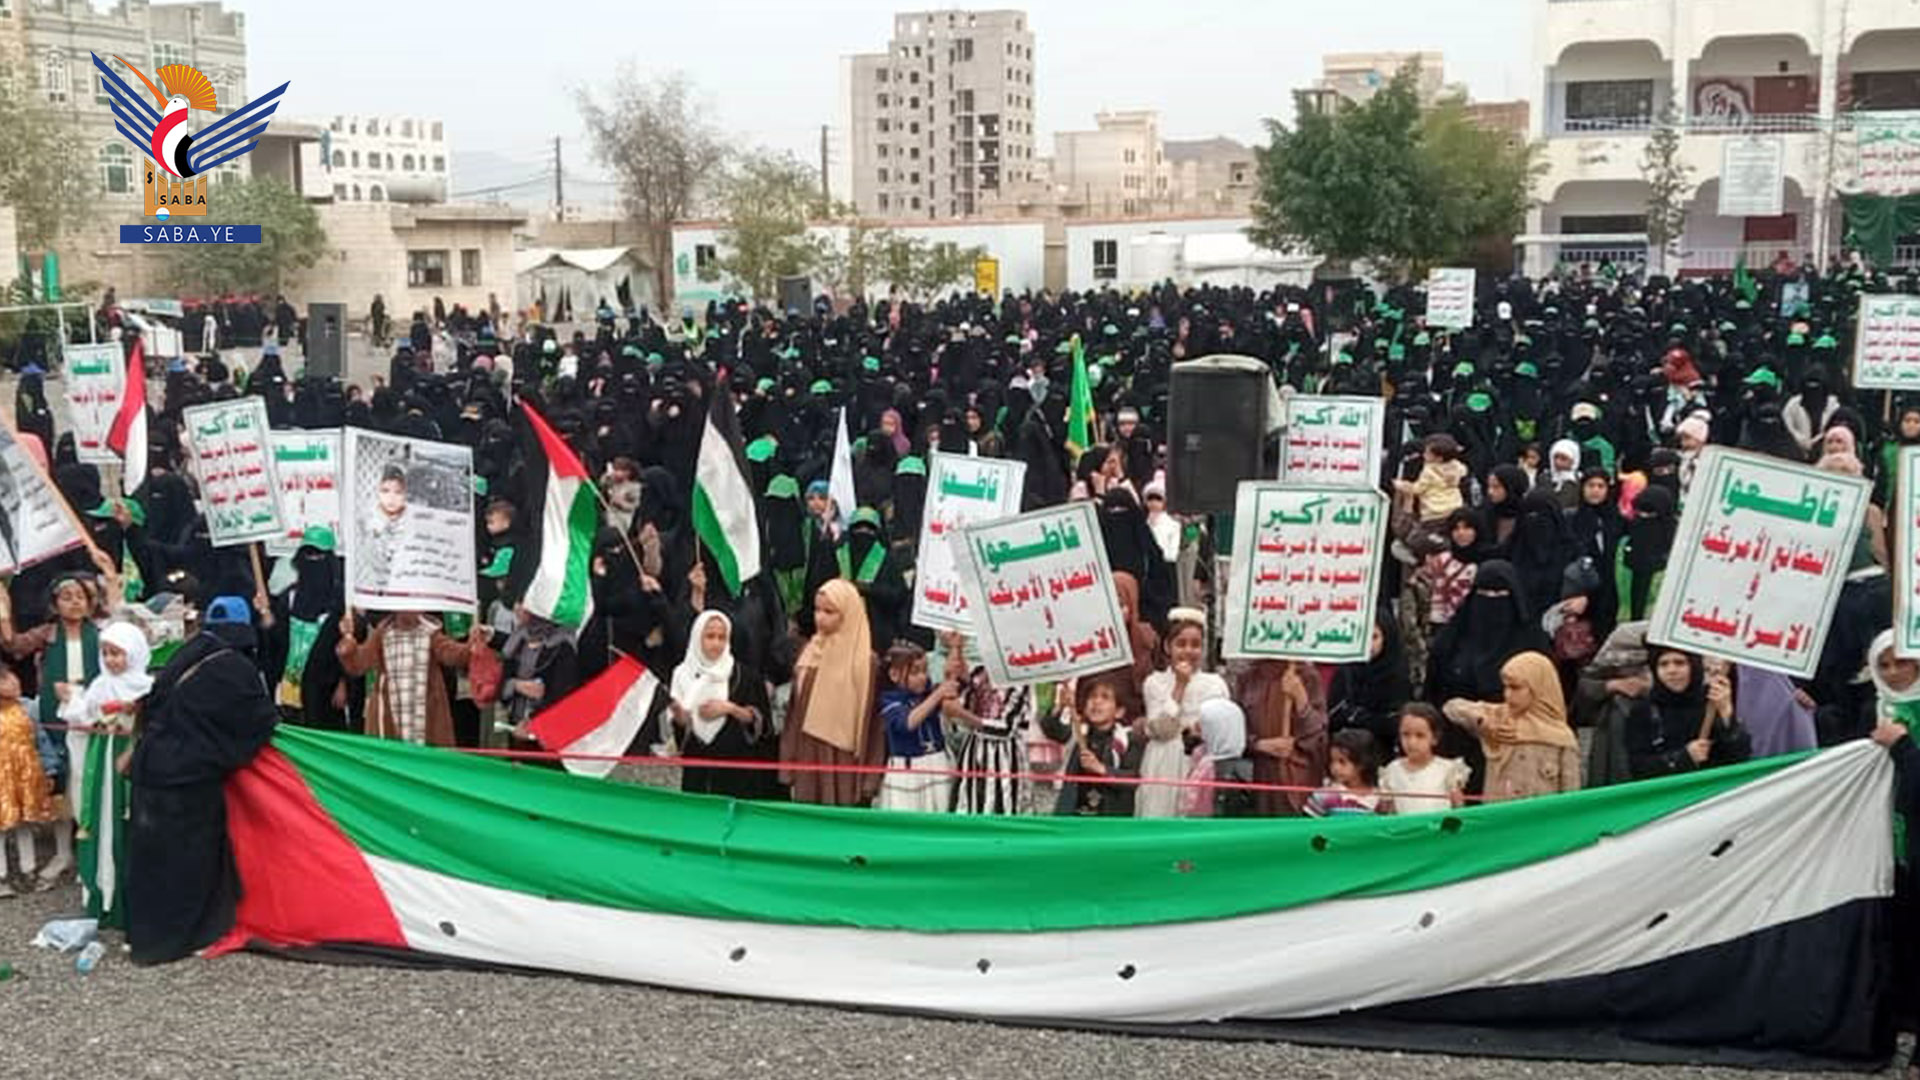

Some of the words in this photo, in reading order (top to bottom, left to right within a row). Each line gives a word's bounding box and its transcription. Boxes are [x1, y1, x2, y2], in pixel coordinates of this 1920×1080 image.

[1332, 499, 1376, 526] الله
[1720, 468, 1842, 528] قاطعوا
[1261, 494, 1331, 533] أكبر
[976, 515, 1082, 573] قاطعوا
[1258, 534, 1317, 558] لأمريكا
[1322, 536, 1372, 559] الموت
[1701, 519, 1771, 563] الأمريكية
[1770, 538, 1836, 579] البضائع
[988, 570, 1046, 610] الأمريكية
[1049, 560, 1099, 600] البضائع
[1320, 565, 1368, 588] الموت
[1746, 572, 1761, 600] و
[1252, 593, 1294, 612] اليهود
[1297, 595, 1322, 615] على
[1328, 592, 1364, 613] اللعنة
[1311, 617, 1362, 648] النصر
